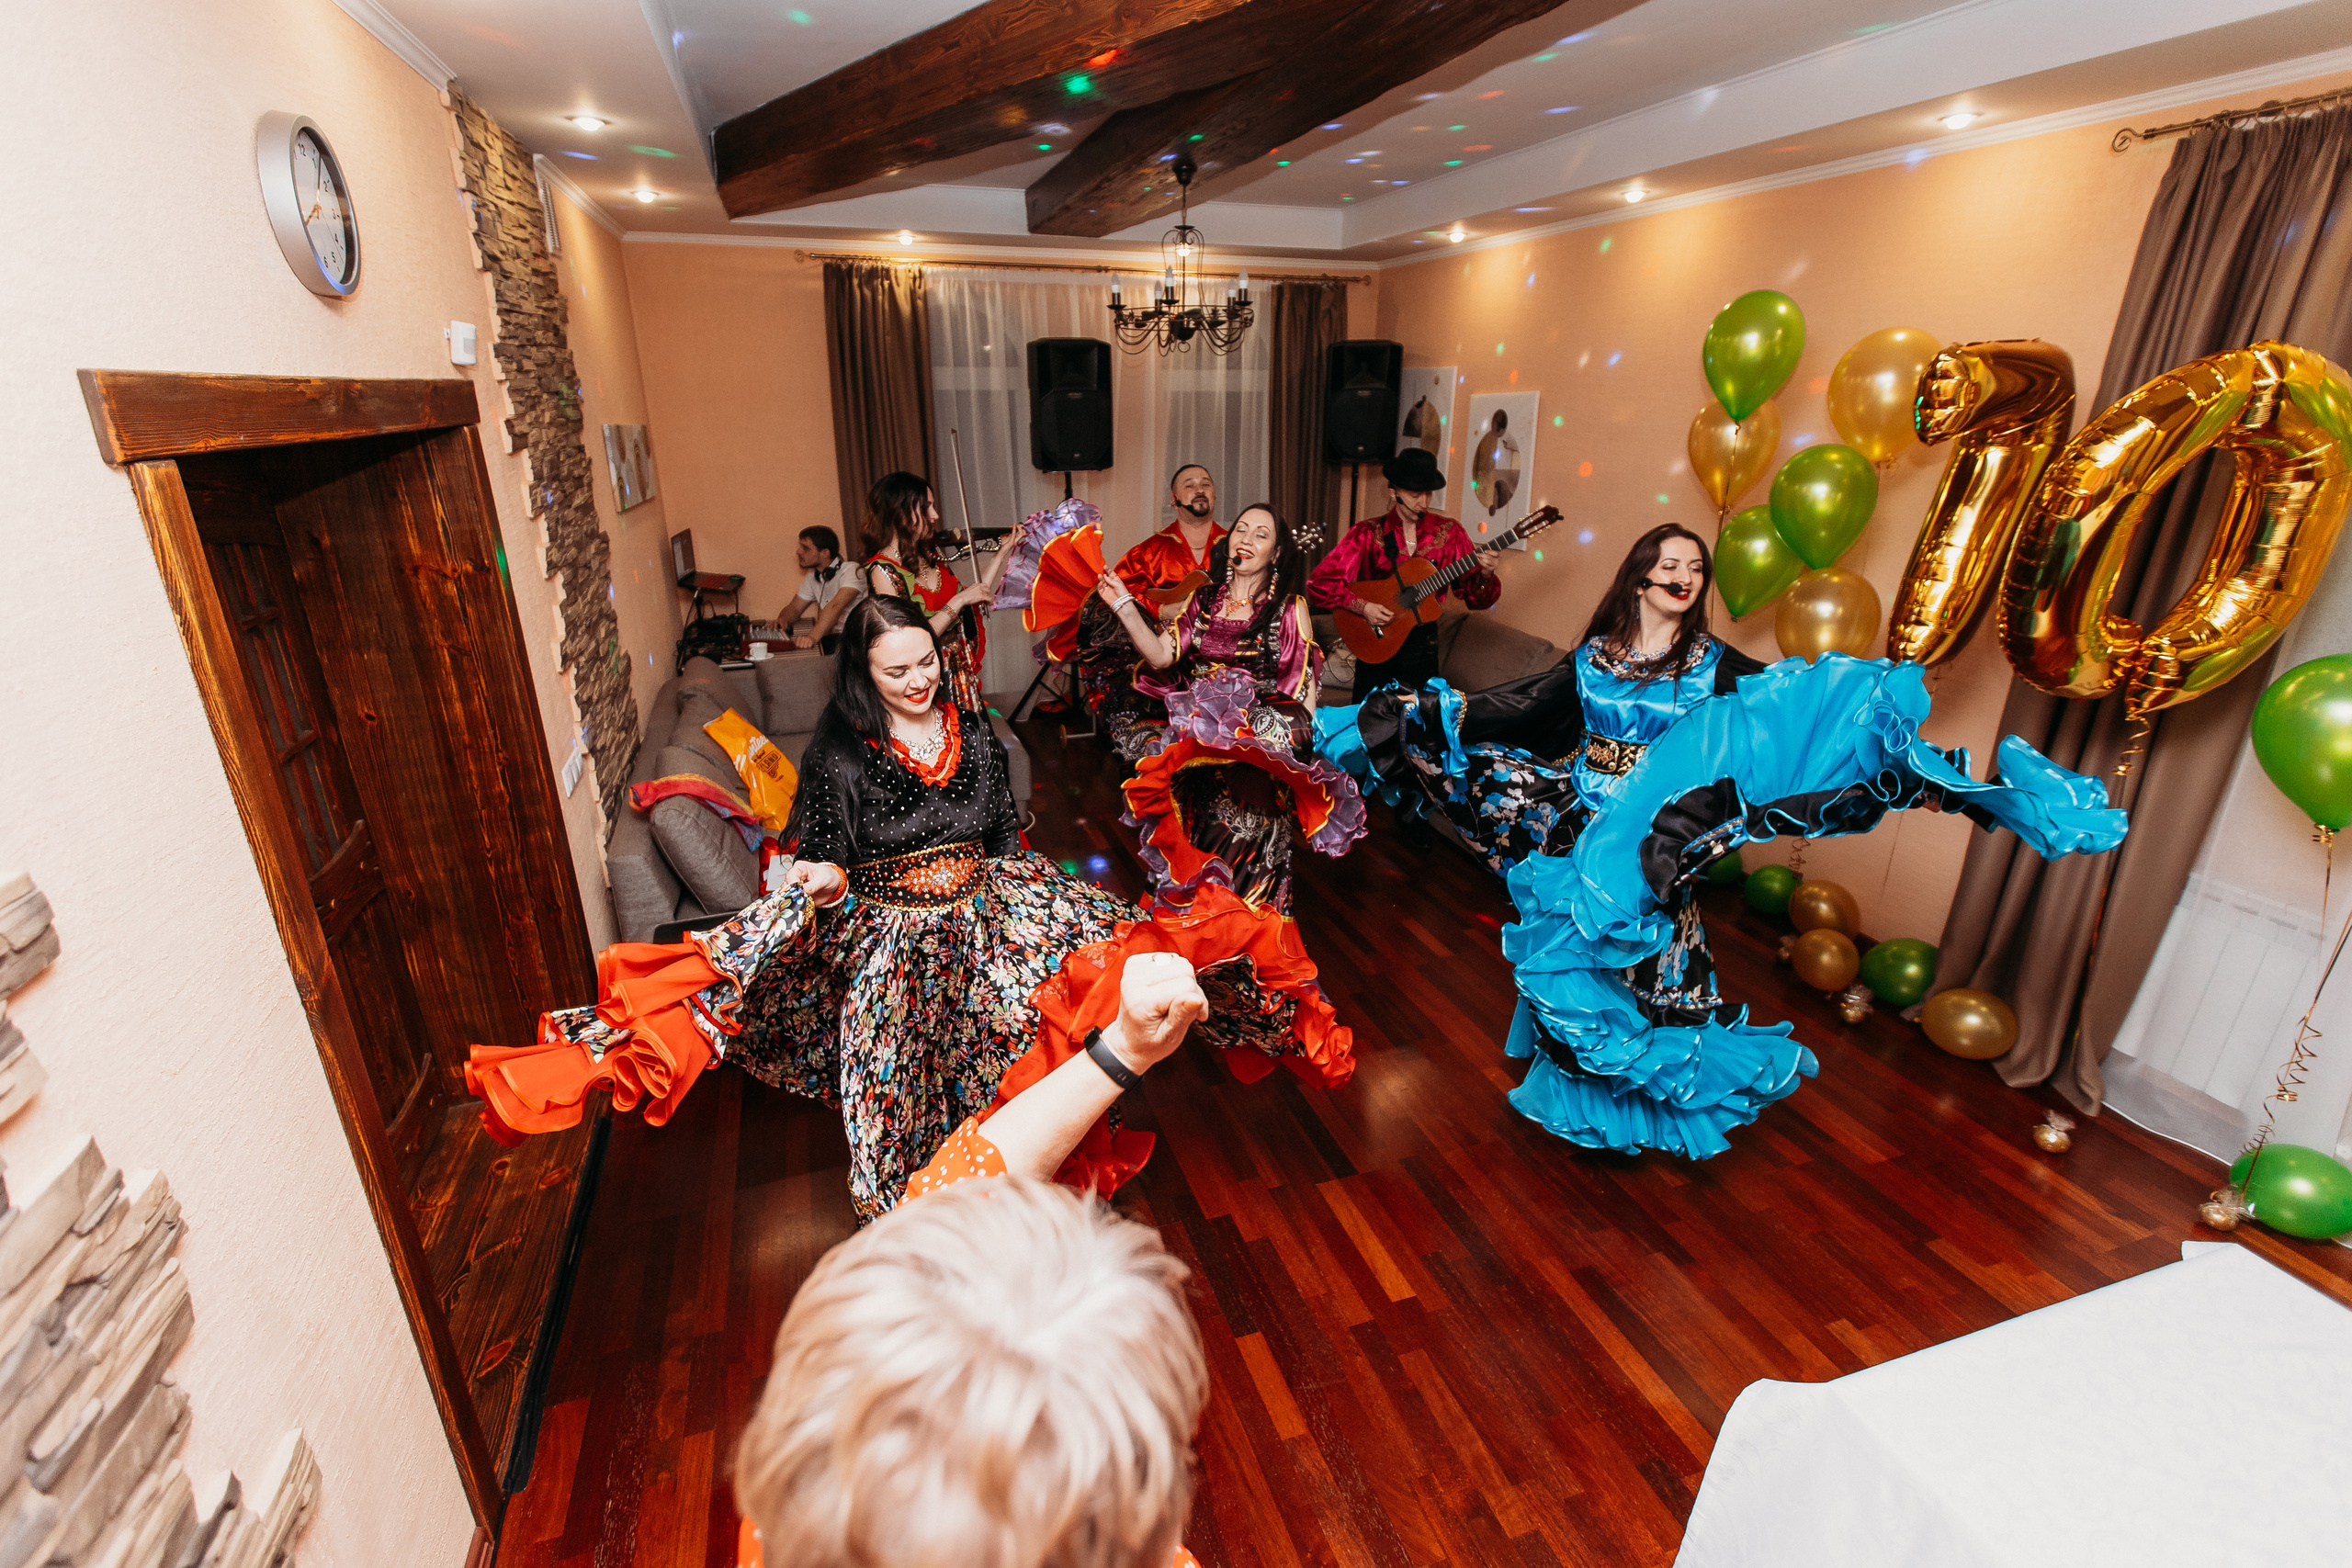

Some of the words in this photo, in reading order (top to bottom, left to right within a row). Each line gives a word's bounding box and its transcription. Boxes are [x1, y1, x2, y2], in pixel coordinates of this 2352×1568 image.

[298, 142, 307, 157] 12
[322, 180, 328, 193] 2
[331, 208, 337, 220] 3
[331, 251, 336, 264] 5
[1886, 337, 2352, 707] 70
